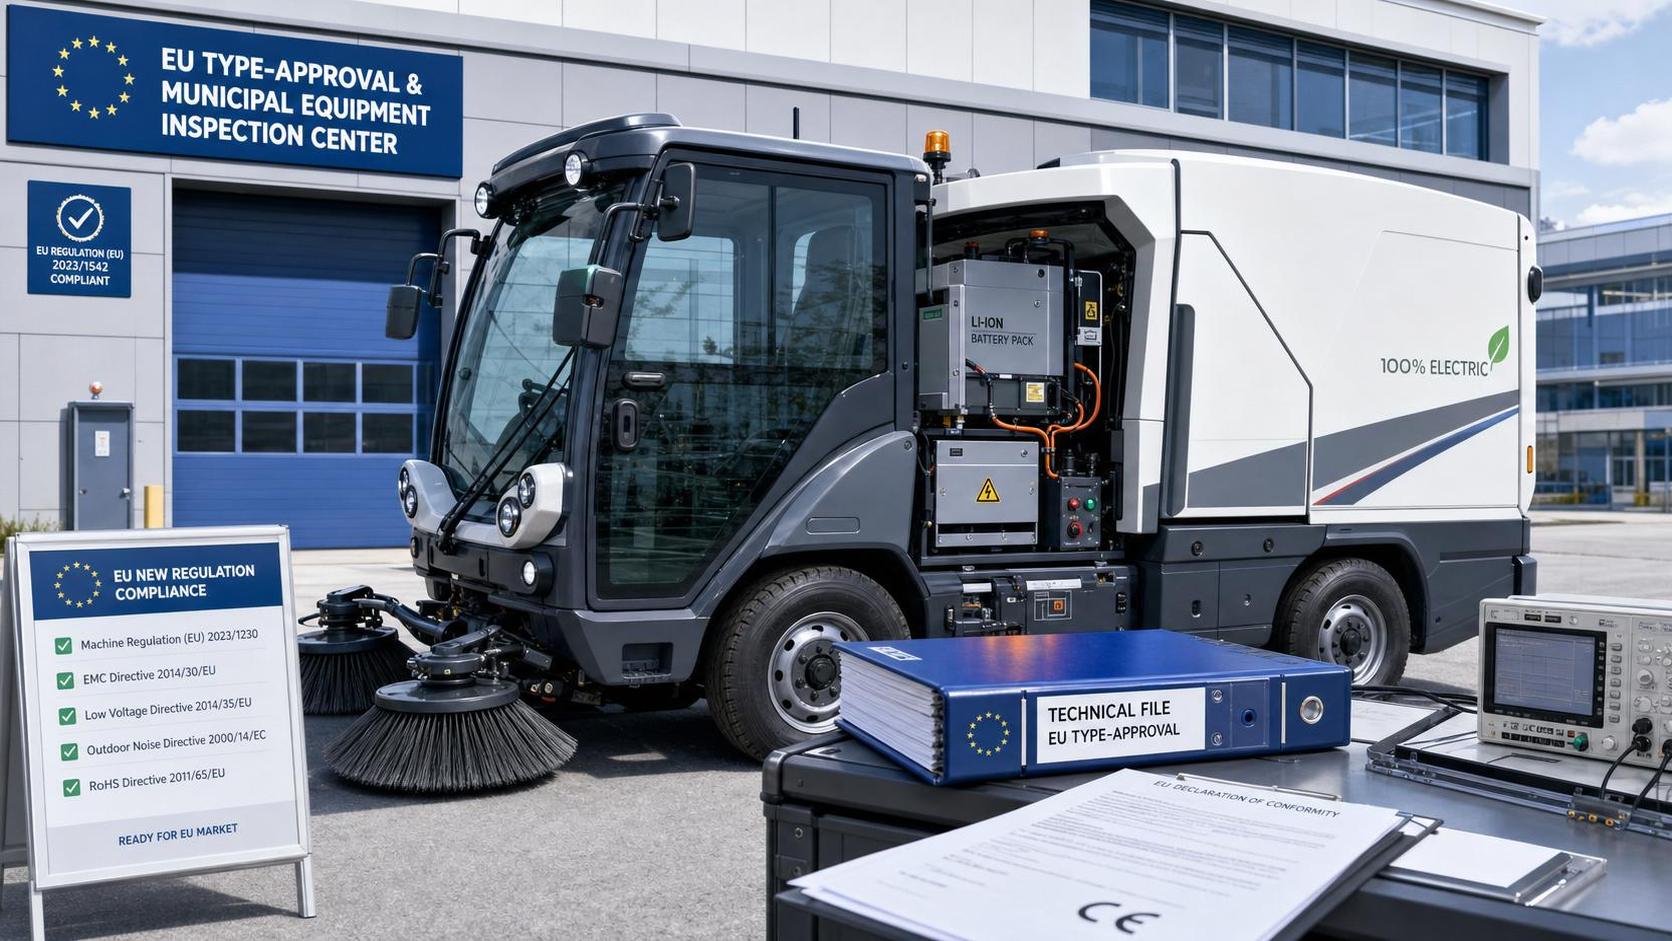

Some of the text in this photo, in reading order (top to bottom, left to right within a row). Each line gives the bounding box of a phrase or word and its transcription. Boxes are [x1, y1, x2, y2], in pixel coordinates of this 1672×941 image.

[162, 47, 422, 95] EU TYPE-APPROVAL &
[162, 81, 430, 126] MUNICIPAL EQUIPMENT
[162, 114, 397, 154] INSPECTION CENTER
[36, 246, 123, 260] EU REGULATION (EU)
[53, 260, 108, 272] 2023/1542
[51, 275, 110, 285] COMPLIANT
[972, 316, 1003, 328] LI-ION
[972, 334, 1033, 345] BATTERY PACK
[1381, 358, 1488, 376] 100% ELECTRIC
[114, 565, 255, 583] EU NEW REGULATION
[115, 584, 206, 601] COMPLIANCE
[81, 629, 258, 650] Machine Regulation (EU) 2023/1230
[84, 665, 216, 685] EMC Directive 2014/30/EU
[85, 697, 252, 720] Low Voltage Directive 2014/35/EU
[1048, 700, 1170, 722] TECHNICAL FILE
[87, 730, 266, 756] Outdoor Noise Directive 2000/14/EC
[1048, 722, 1180, 745] EU TYPE-APPROVAL
[90, 768, 225, 791] RoHS Directive 2011/65/EU
[1173, 784, 1247, 802] DECLARATION
[1266, 800, 1340, 818] CONFORMITY
[118, 823, 237, 846] READY FOR EU MARKET
[1077, 901, 1160, 934] CE
